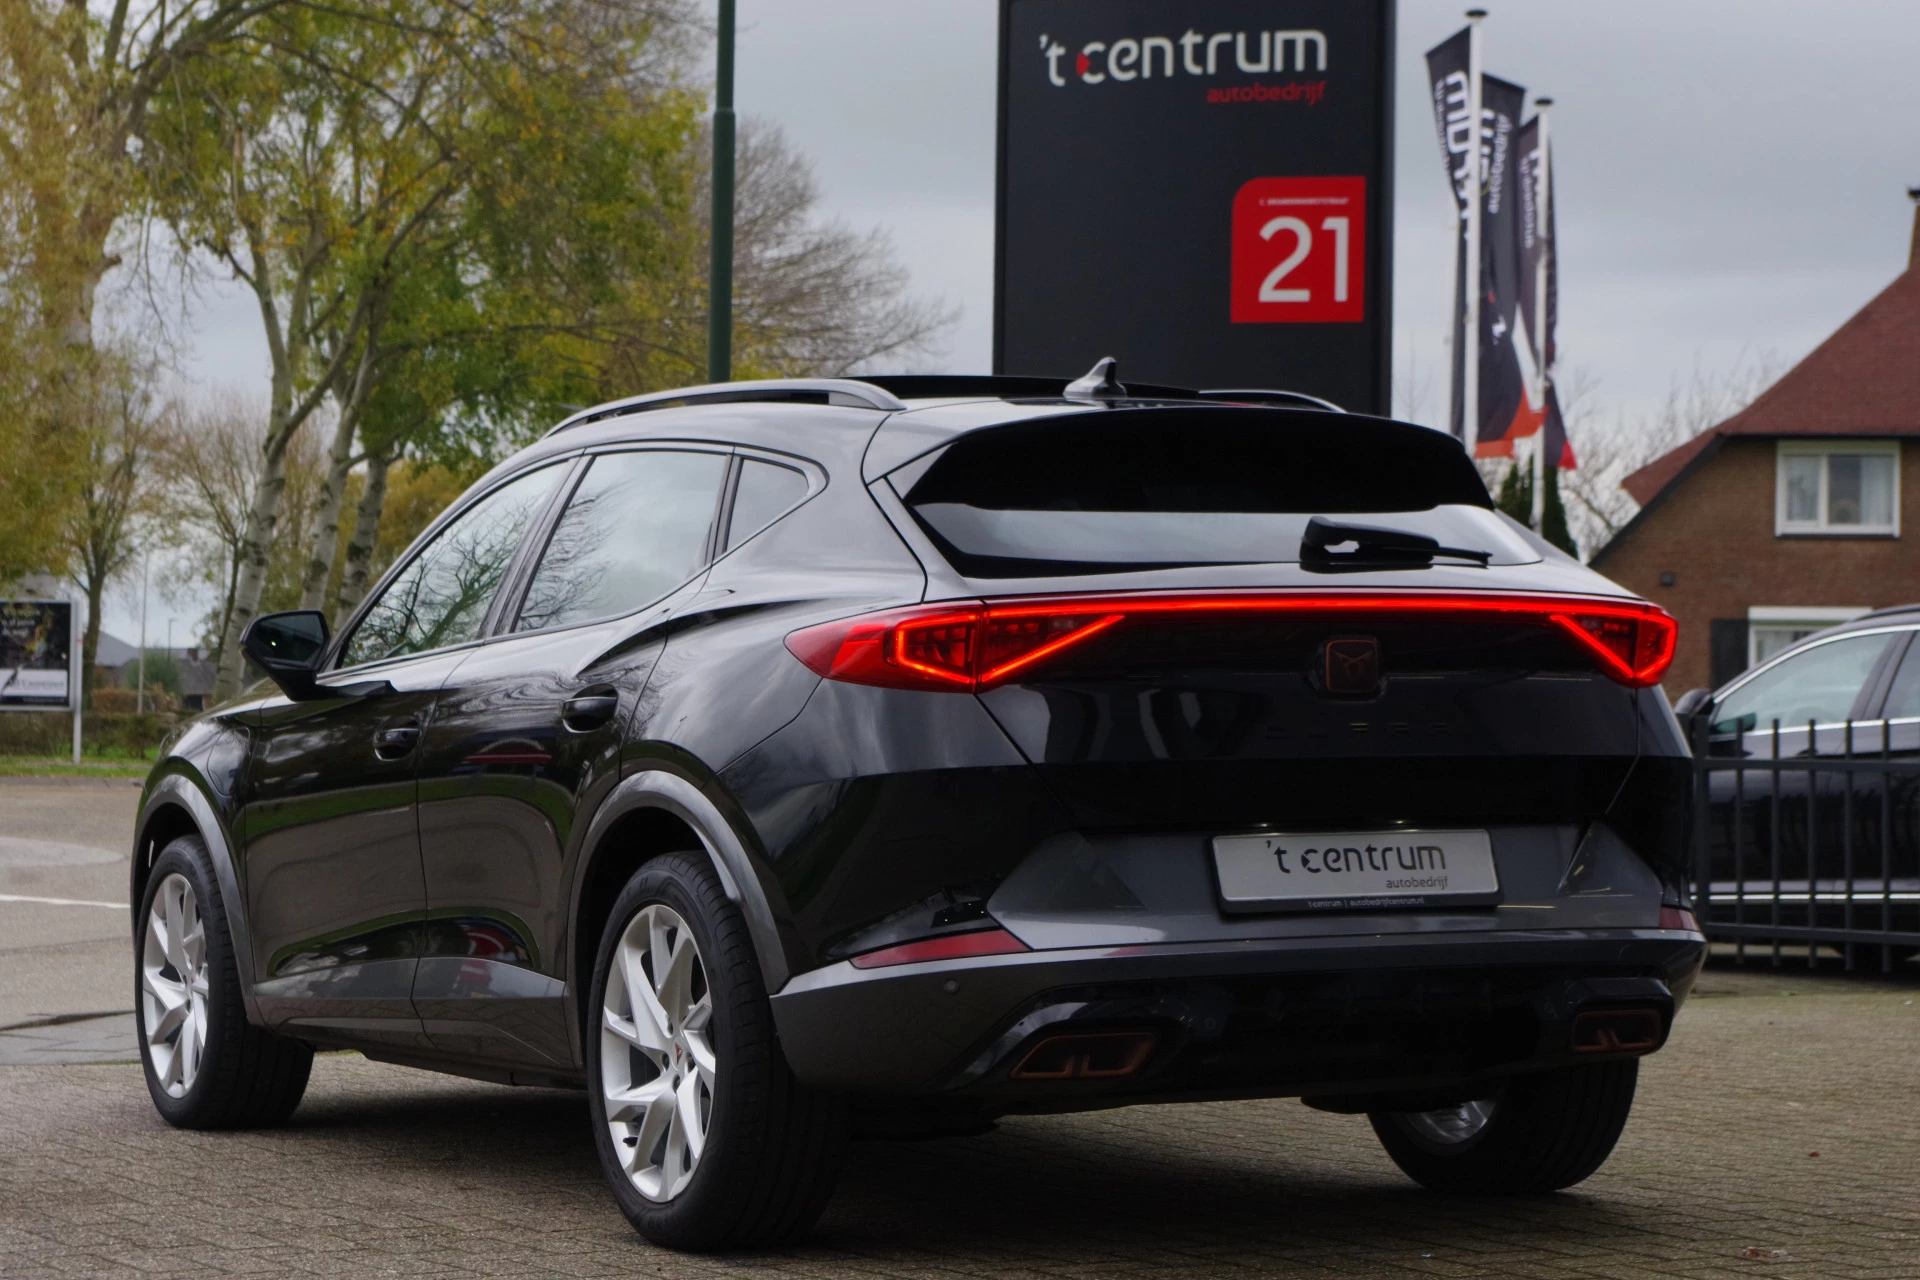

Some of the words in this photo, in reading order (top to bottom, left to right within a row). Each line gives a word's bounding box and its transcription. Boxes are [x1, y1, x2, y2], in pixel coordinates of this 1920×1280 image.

[1039, 33, 1066, 87] 't
[1076, 29, 1328, 84] centrum
[1207, 80, 1327, 105] autobedrijf
[1258, 216, 1349, 303] 21
[1266, 840, 1291, 874] 't
[1301, 845, 1447, 874] centrum
[1386, 875, 1449, 890] autobedrijf
